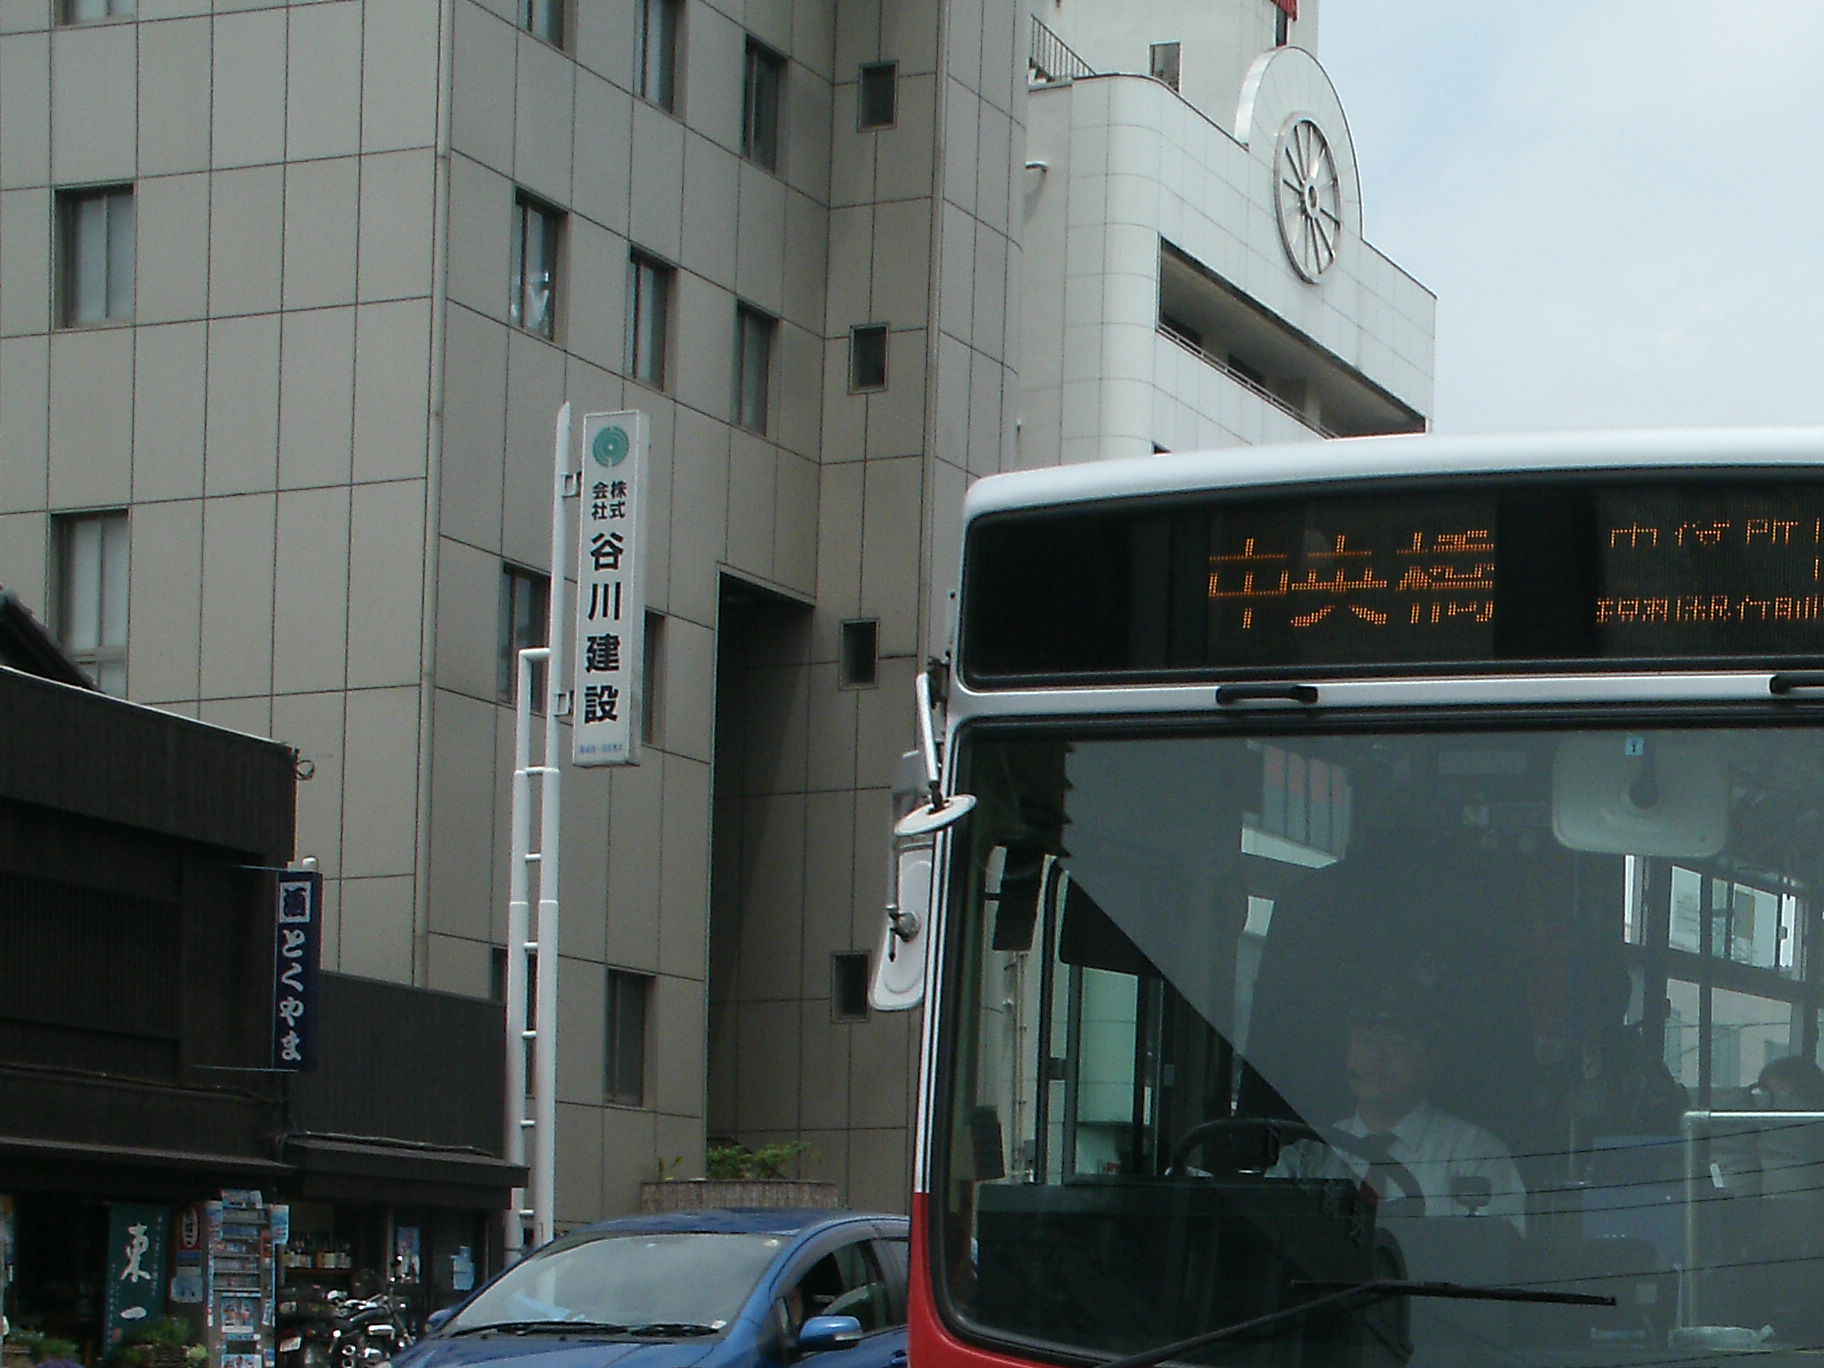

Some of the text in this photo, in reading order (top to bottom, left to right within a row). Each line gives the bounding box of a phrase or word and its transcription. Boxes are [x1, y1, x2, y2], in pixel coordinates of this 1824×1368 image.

[583, 531, 625, 725] 谷川建設
[282, 928, 305, 1062] とくやま
